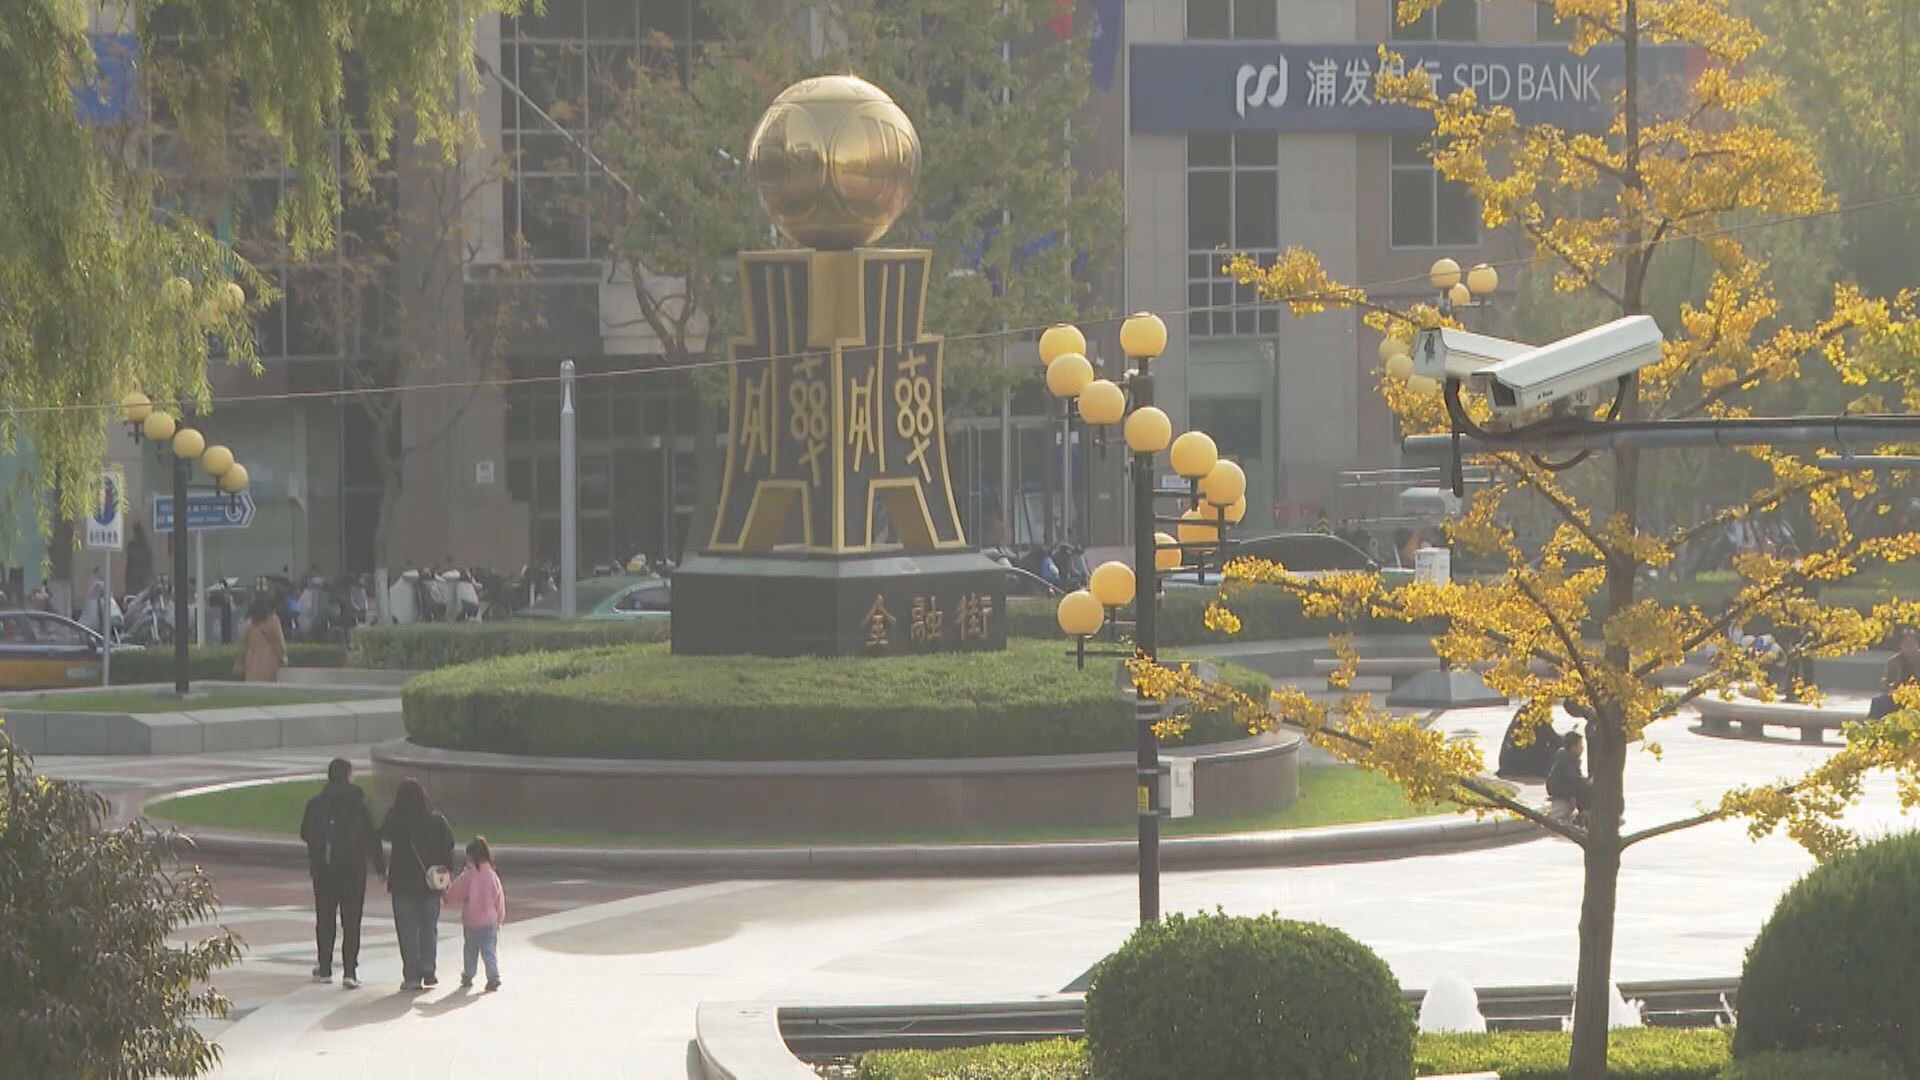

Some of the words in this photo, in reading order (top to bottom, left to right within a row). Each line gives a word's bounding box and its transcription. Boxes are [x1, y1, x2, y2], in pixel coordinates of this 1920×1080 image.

[1453, 63, 1510, 101] SPD
[1518, 63, 1601, 102] BANK
[861, 592, 992, 646] 金融街
